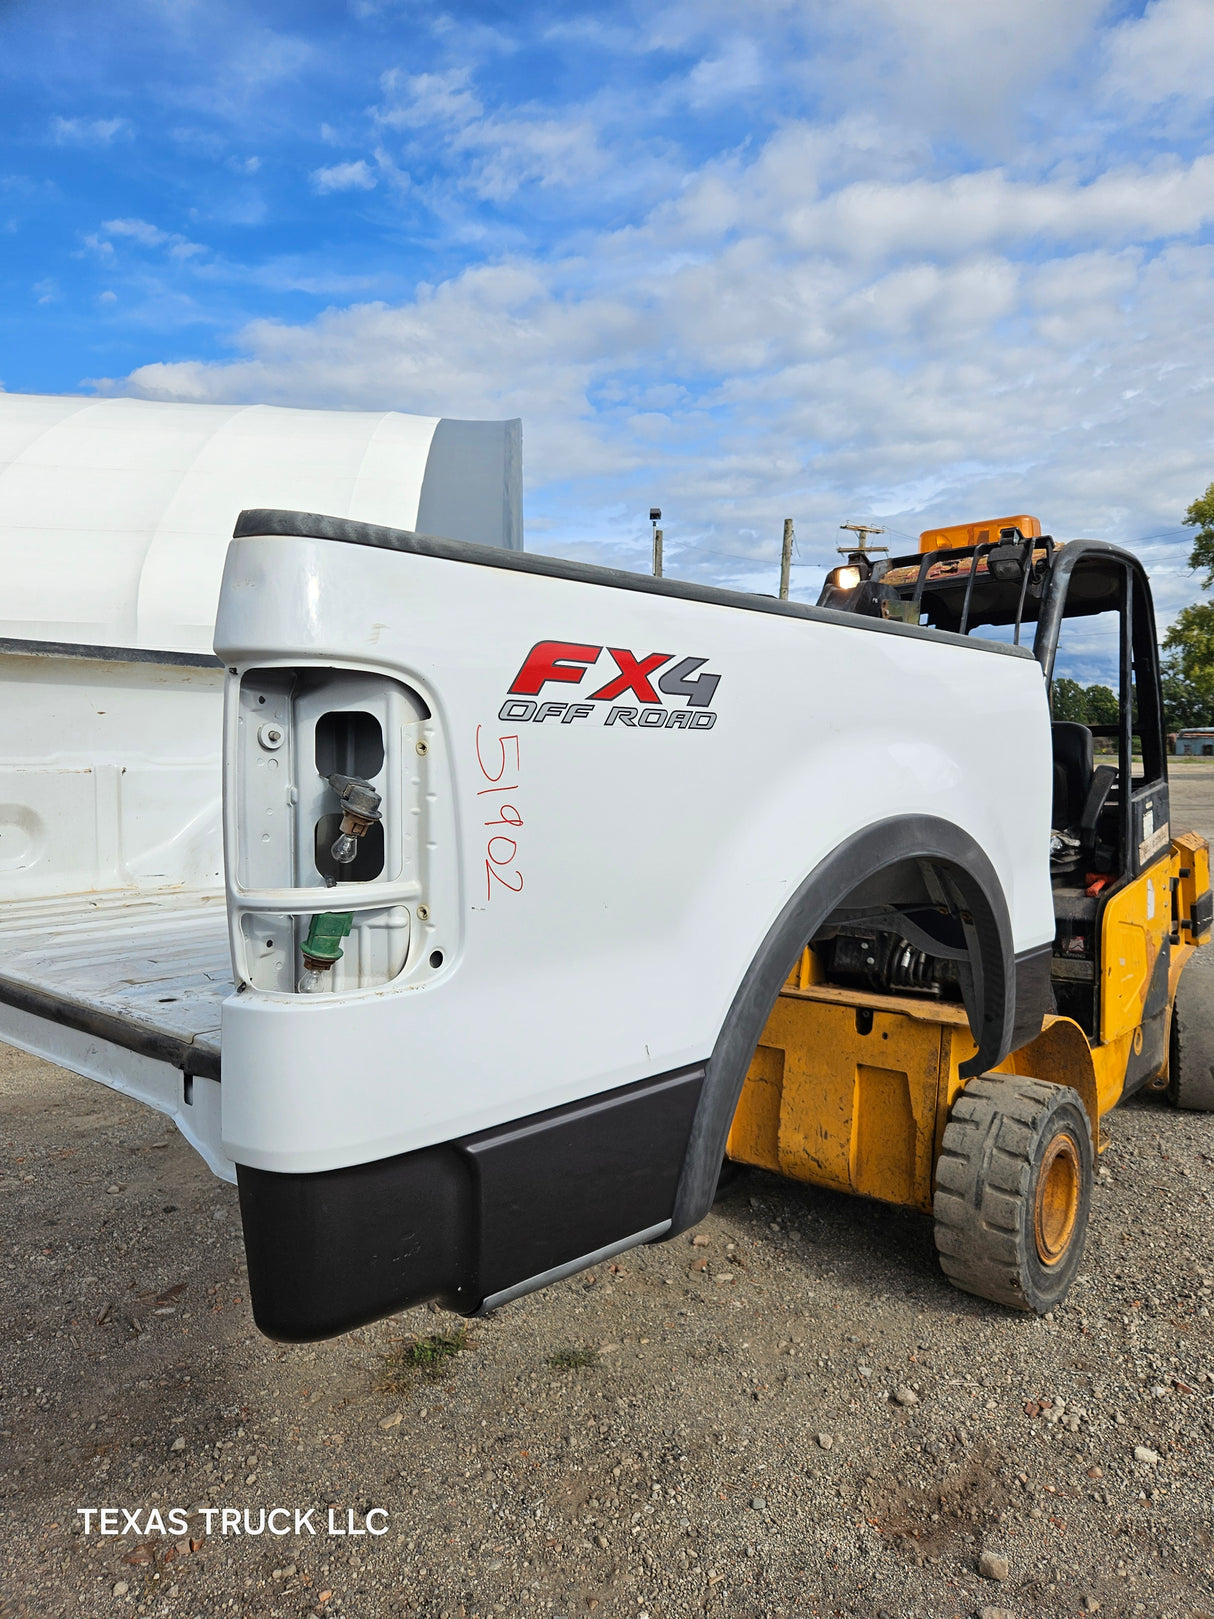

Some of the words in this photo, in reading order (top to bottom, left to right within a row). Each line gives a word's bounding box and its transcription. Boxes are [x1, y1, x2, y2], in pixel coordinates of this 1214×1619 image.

[506, 640, 722, 707] FX4
[498, 699, 595, 724] OFF
[604, 706, 718, 730] ROAD
[476, 724, 524, 901] 51902
